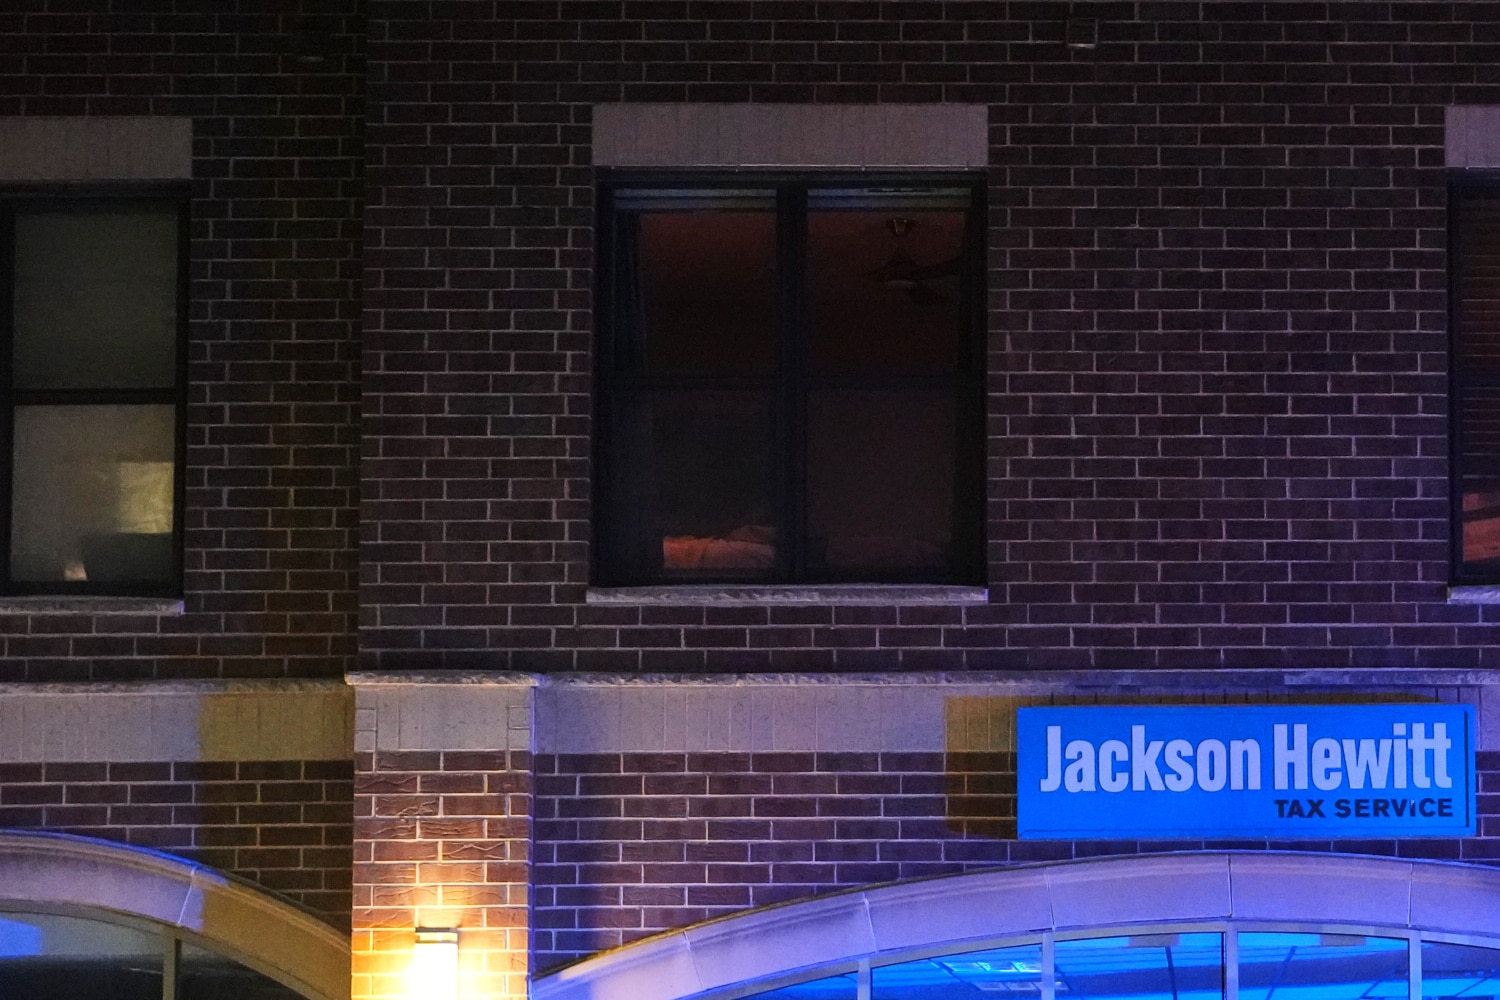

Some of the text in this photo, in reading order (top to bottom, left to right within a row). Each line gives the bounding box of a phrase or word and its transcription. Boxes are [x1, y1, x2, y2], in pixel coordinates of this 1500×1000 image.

[1039, 722, 1452, 793] Jackson Hewitt
[1274, 798, 1454, 819] TAX SERVICE
